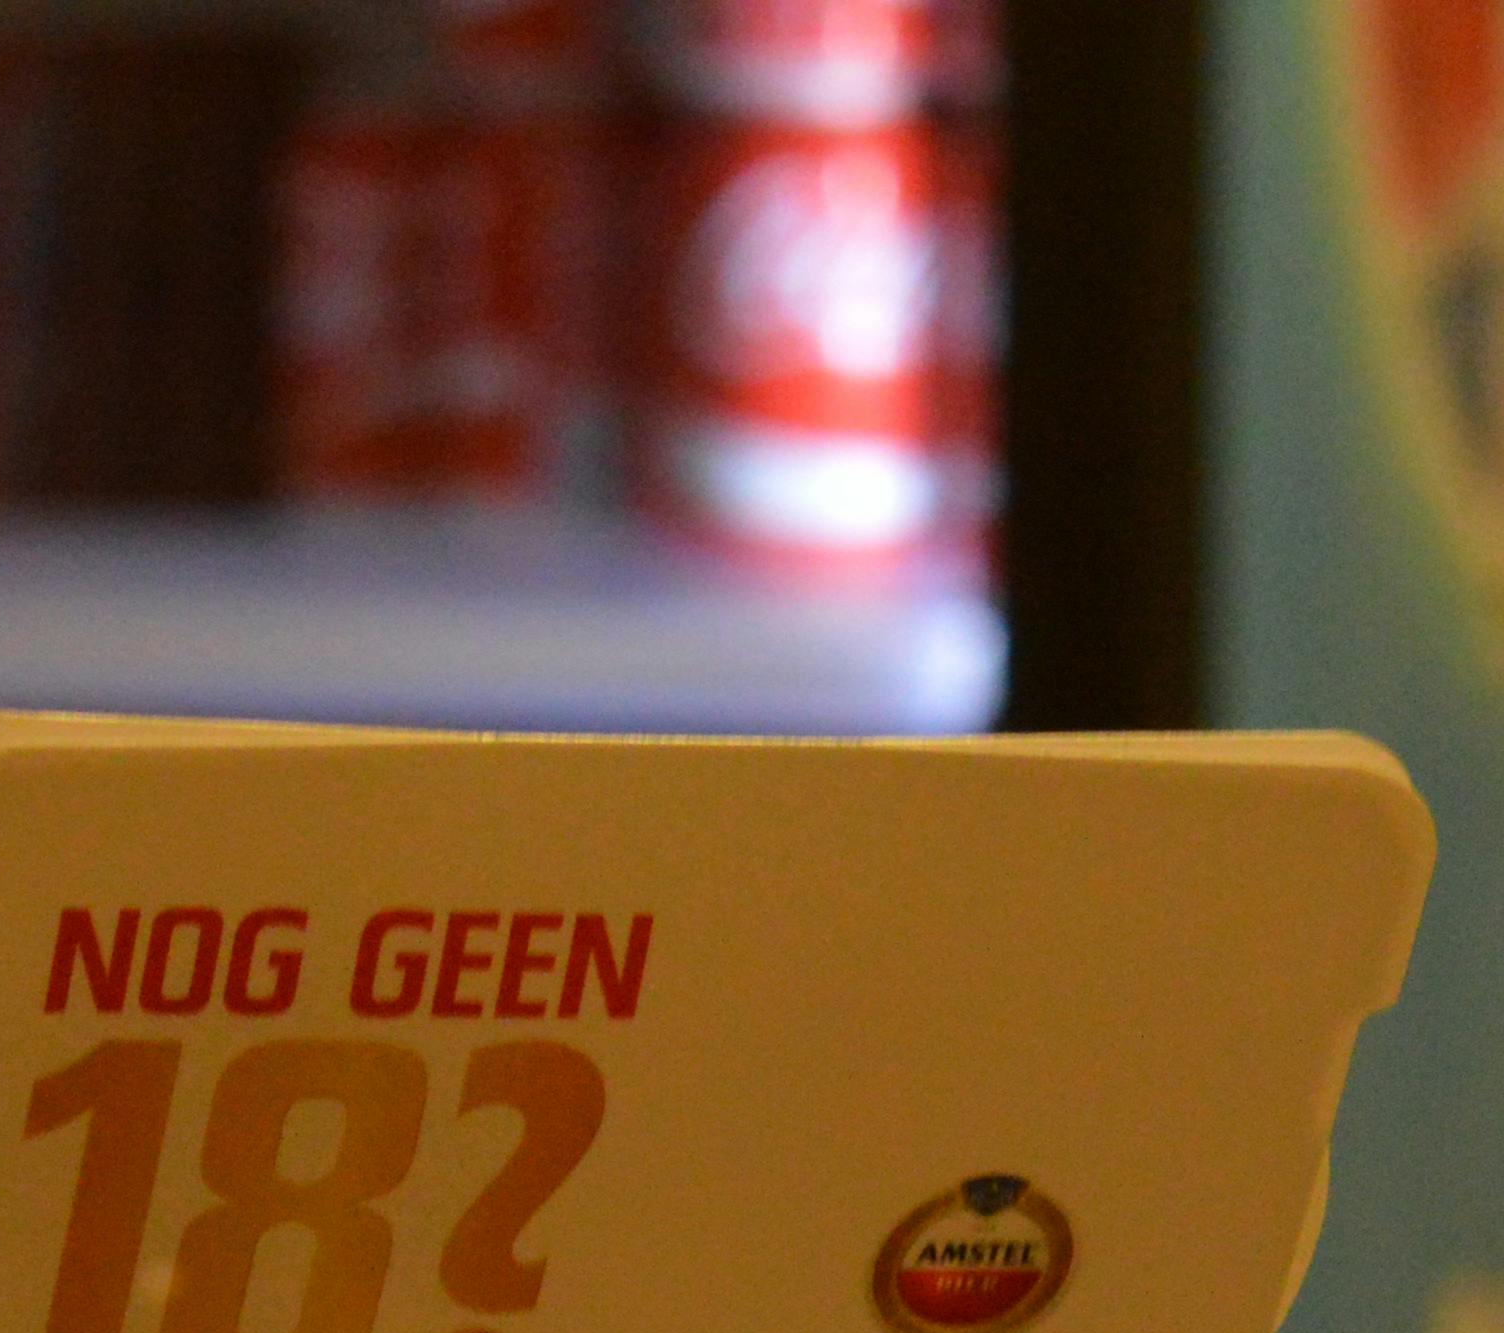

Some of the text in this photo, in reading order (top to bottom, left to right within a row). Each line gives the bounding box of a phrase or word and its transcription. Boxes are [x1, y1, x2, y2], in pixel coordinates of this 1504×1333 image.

[43, 906, 654, 1020] NOG GEEN
[916, 1241, 1035, 1266] AMSTEL
